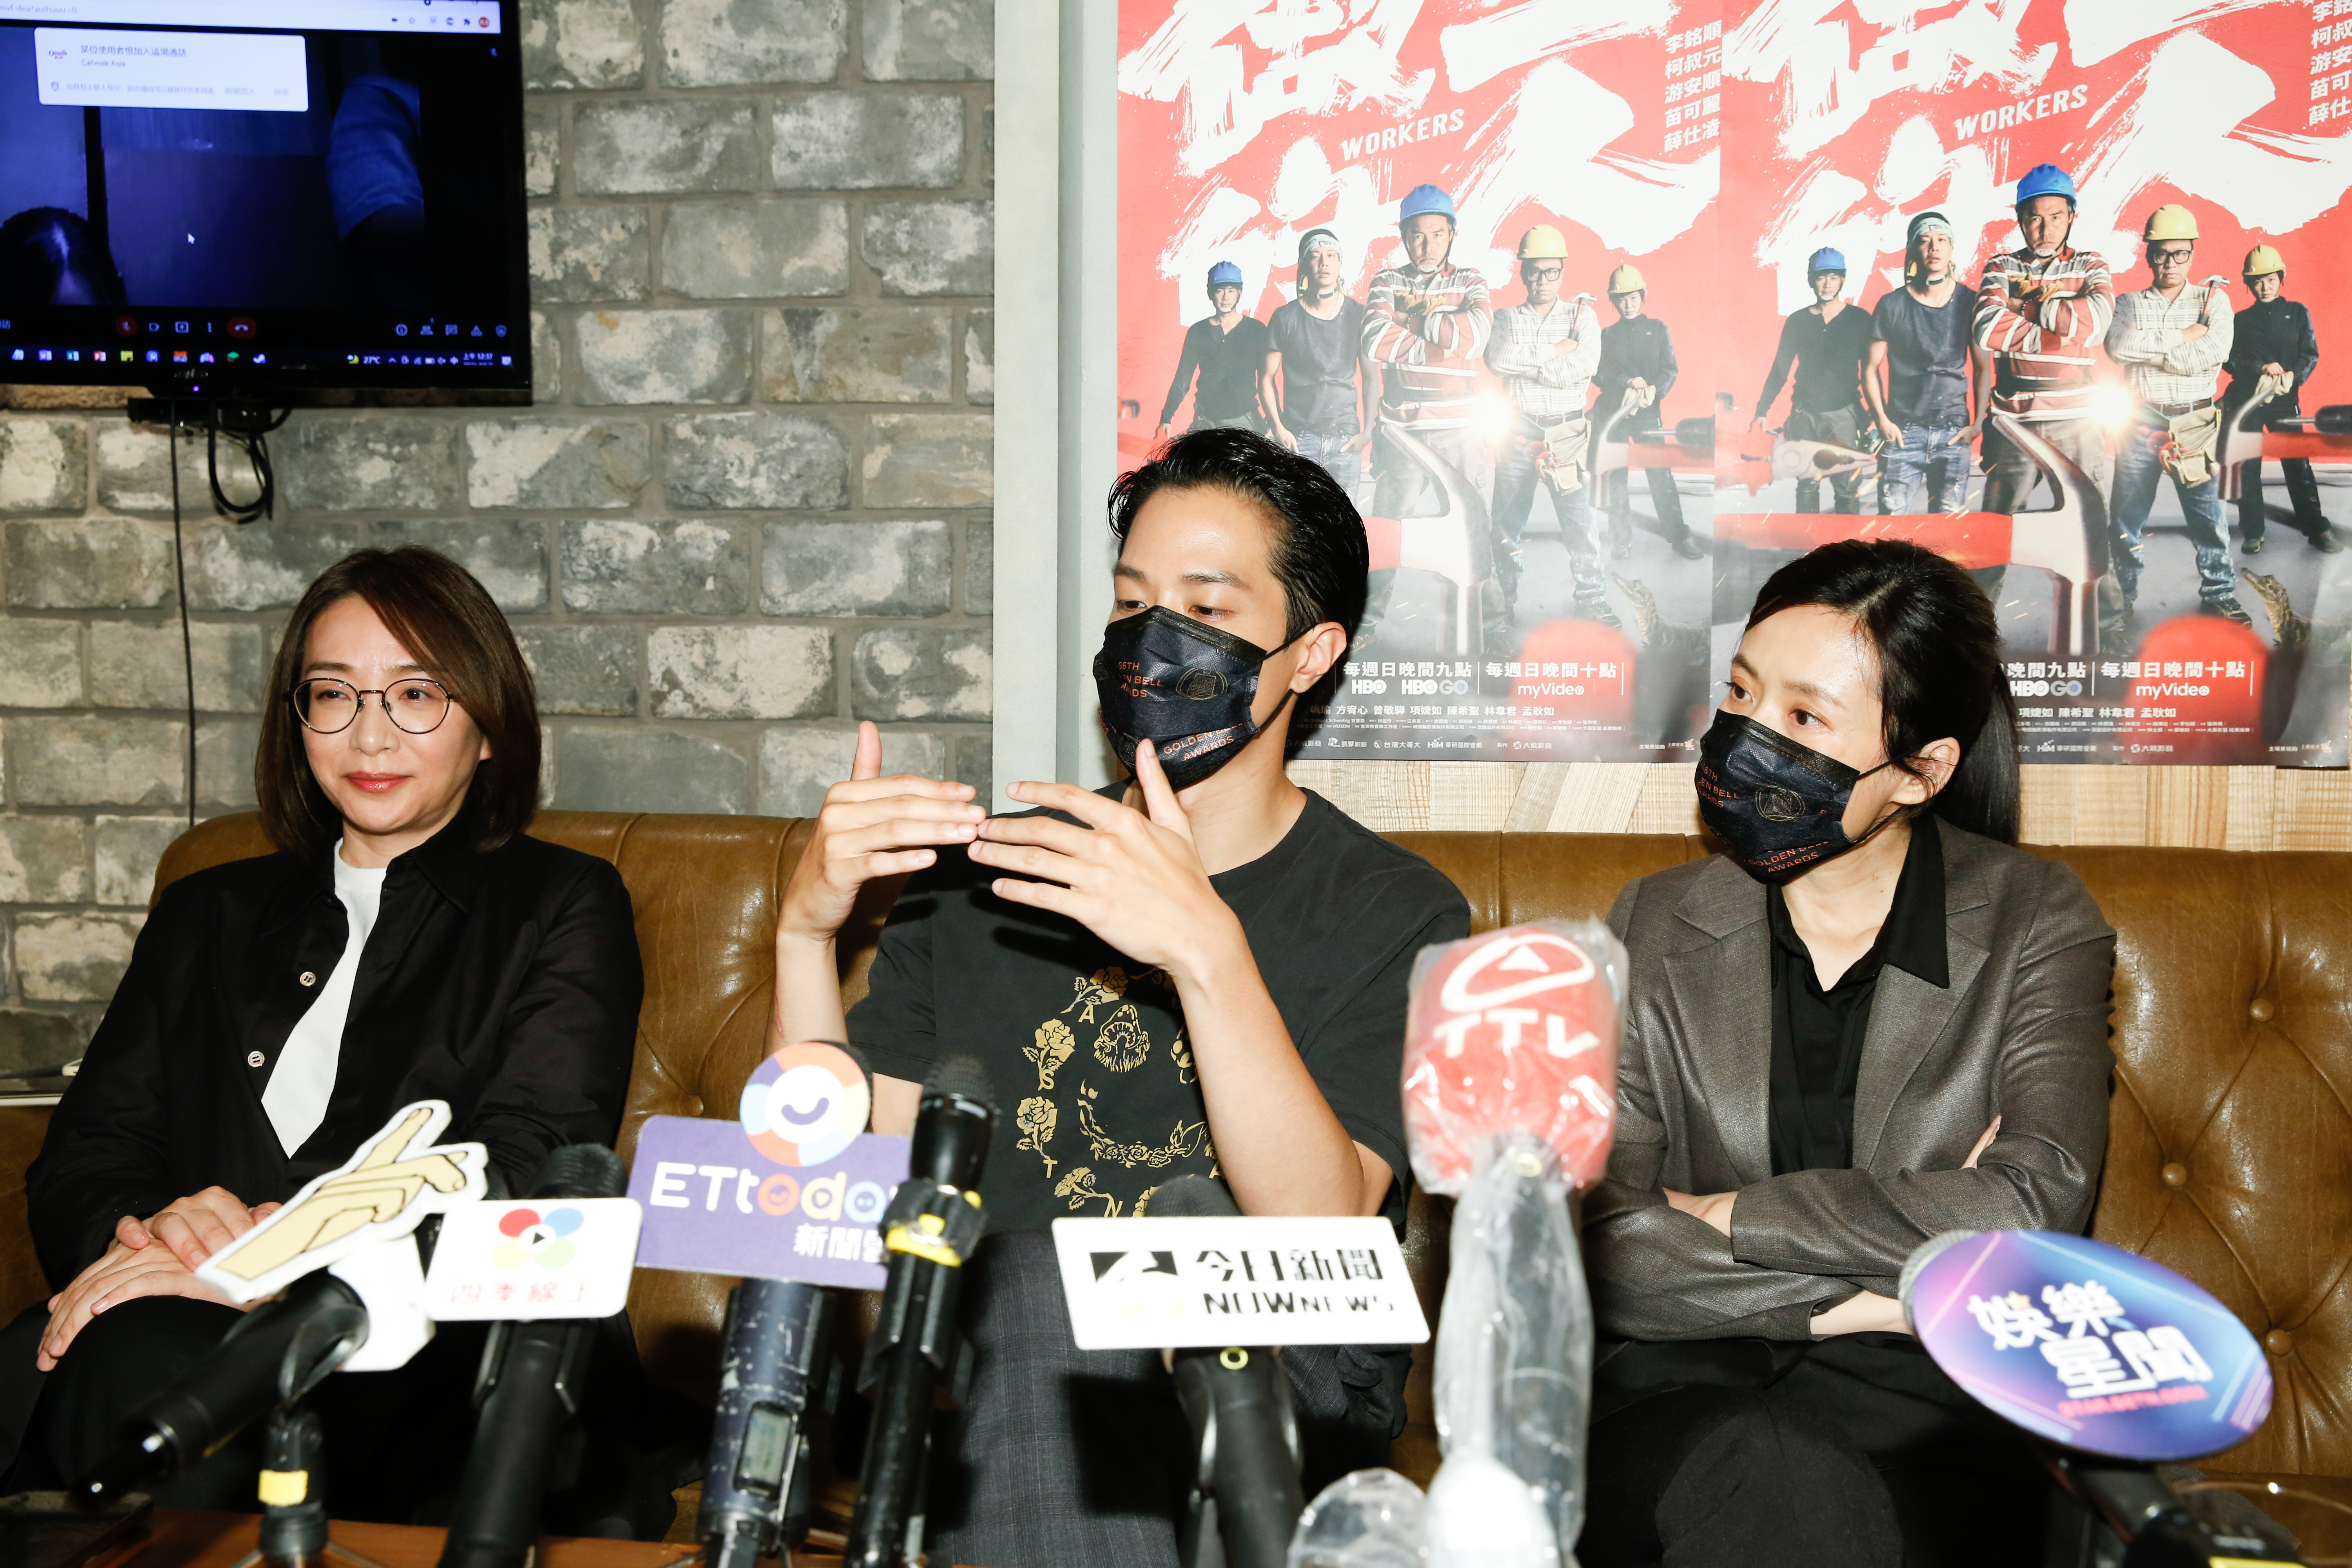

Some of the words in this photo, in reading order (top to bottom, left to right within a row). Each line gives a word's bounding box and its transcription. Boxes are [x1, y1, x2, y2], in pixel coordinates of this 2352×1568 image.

[1665, 20, 1722, 54] 李銘順
[1664, 45, 1722, 79] 柯叔元
[1664, 69, 1721, 104] 游安順
[1664, 93, 1721, 128] 苗可麗
[1955, 84, 2089, 141] WORKERS
[1341, 108, 1465, 161] WORKERS
[1664, 118, 1720, 153] 薛仕凌
[1119, 662, 1140, 670] 56TH
[1343, 661, 1472, 678] 每週日晚間九點
[1486, 662, 1617, 678] 每週日晚間十點
[2100, 661, 2245, 678] 每週日晚間十點
[1135, 676, 1163, 686] BELL
[1351, 679, 1387, 695] HBO
[1517, 682, 1585, 699] myVideo
[2136, 682, 2210, 700] myVideo
[1336, 705, 1368, 715] 方宥心
[1373, 705, 1405, 715] 曾敬驊
[1410, 706, 1442, 715] 項婕如
[1447, 706, 1479, 715] 陳希聖
[1484, 706, 1517, 716] 林韋君
[1521, 706, 1555, 716] 孟耿如
[2058, 708, 2094, 718] 陳希聖
[2099, 708, 2135, 718] 林韋君
[2140, 708, 2176, 718] 孟耿如
[1164, 732, 1213, 754] GOLDEN
[1183, 735, 1235, 761] AWARDS
[1713, 786, 1741, 800] BELL
[1748, 849, 1796, 866] GOLDEN
[1768, 852, 1819, 873] AWARDS
[1433, 1008, 1601, 1059] TTV
[649, 1161, 899, 1224] ETtoda
[1196, 1249, 1383, 1281] 今日新聞
[450, 1281, 594, 1305] 四季線上
[1967, 1279, 2125, 1351] 娛樂
